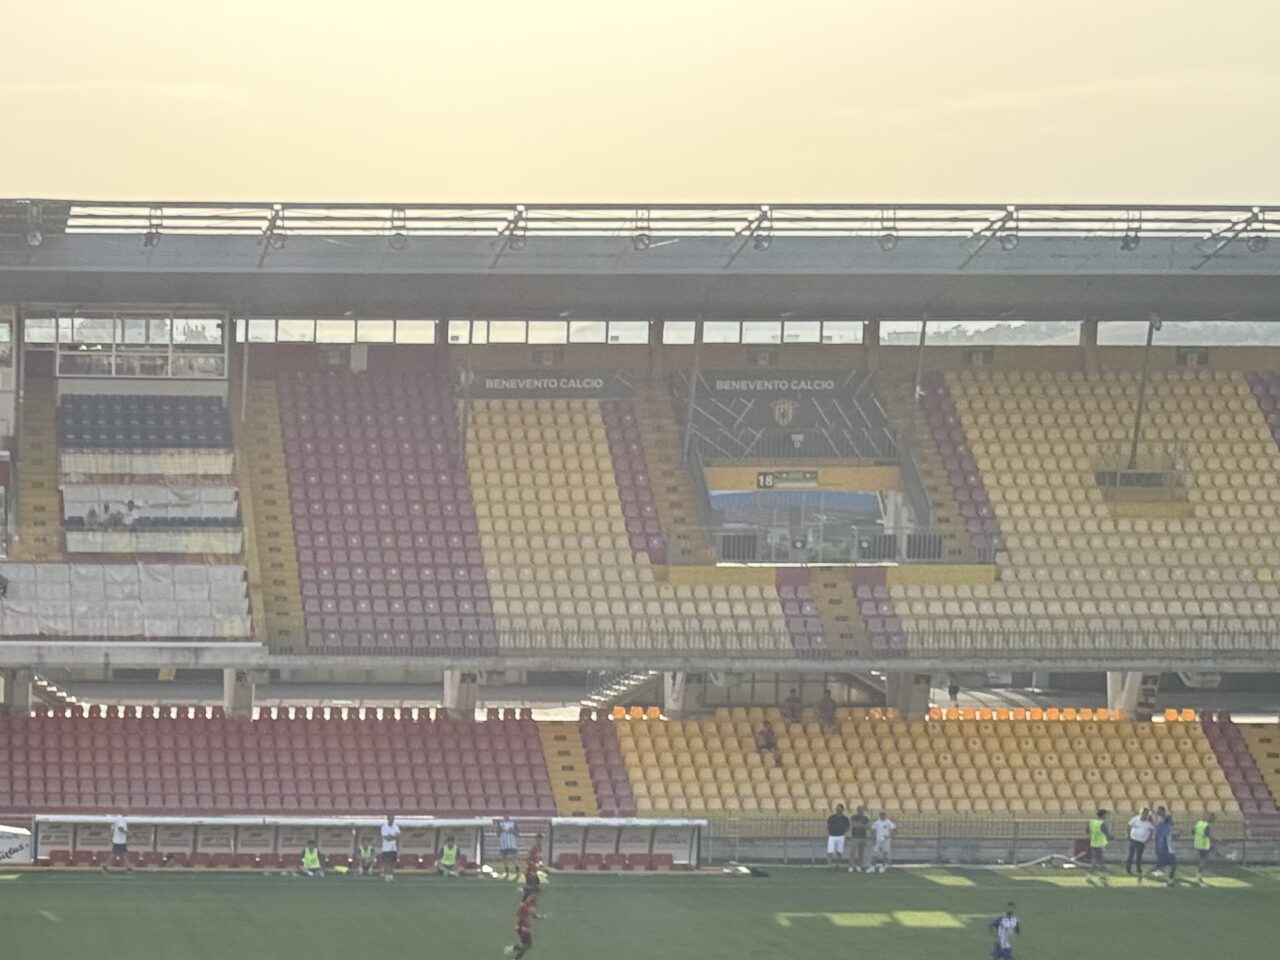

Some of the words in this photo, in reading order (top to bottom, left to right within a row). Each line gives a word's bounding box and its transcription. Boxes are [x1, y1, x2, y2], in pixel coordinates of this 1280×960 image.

[485, 379, 558, 389] BENEVENTO
[559, 379, 604, 388] CALCIO
[715, 380, 789, 390] BENEVENTO
[790, 380, 835, 390] CALCIO
[758, 474, 773, 487] 18
